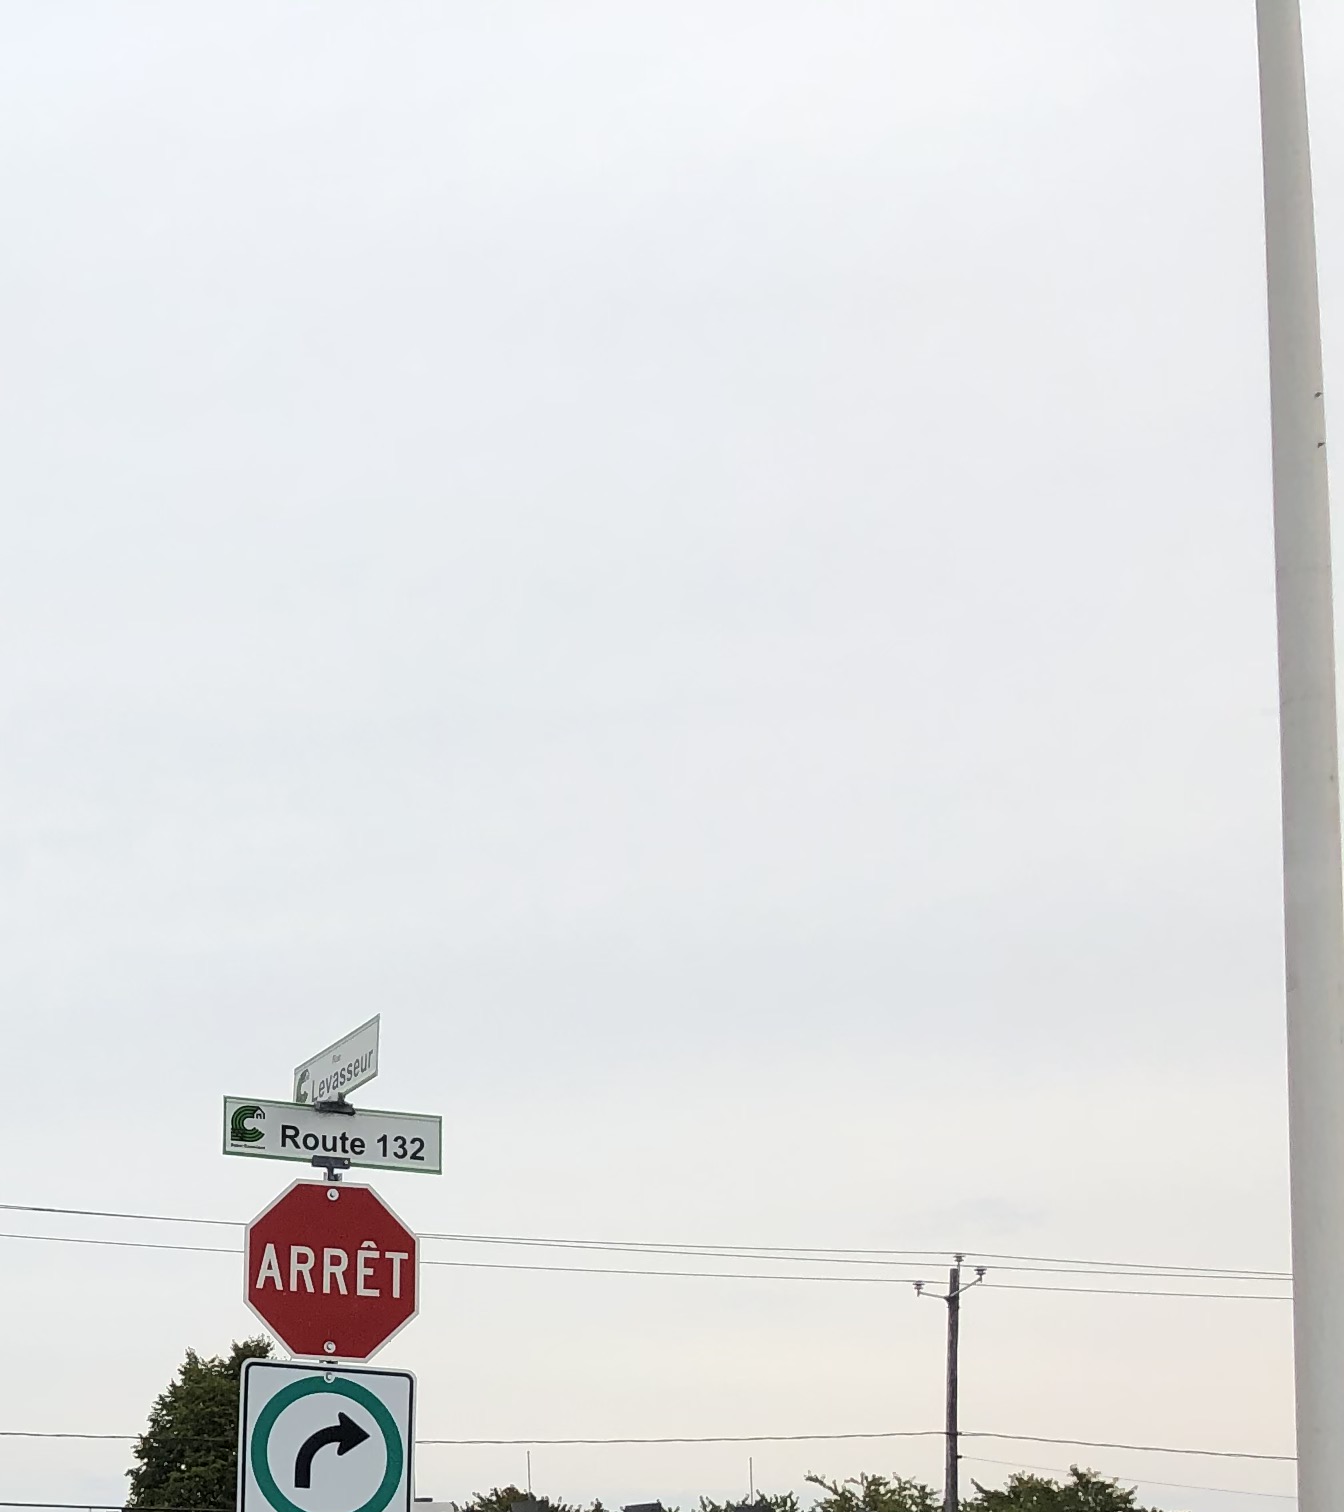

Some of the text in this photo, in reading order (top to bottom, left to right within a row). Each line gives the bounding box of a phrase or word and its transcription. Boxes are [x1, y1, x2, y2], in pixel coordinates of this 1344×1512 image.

[312, 1049, 374, 1101] Levasseur
[280, 1124, 425, 1161] Route 132
[255, 1240, 409, 1299] ARRÊT
